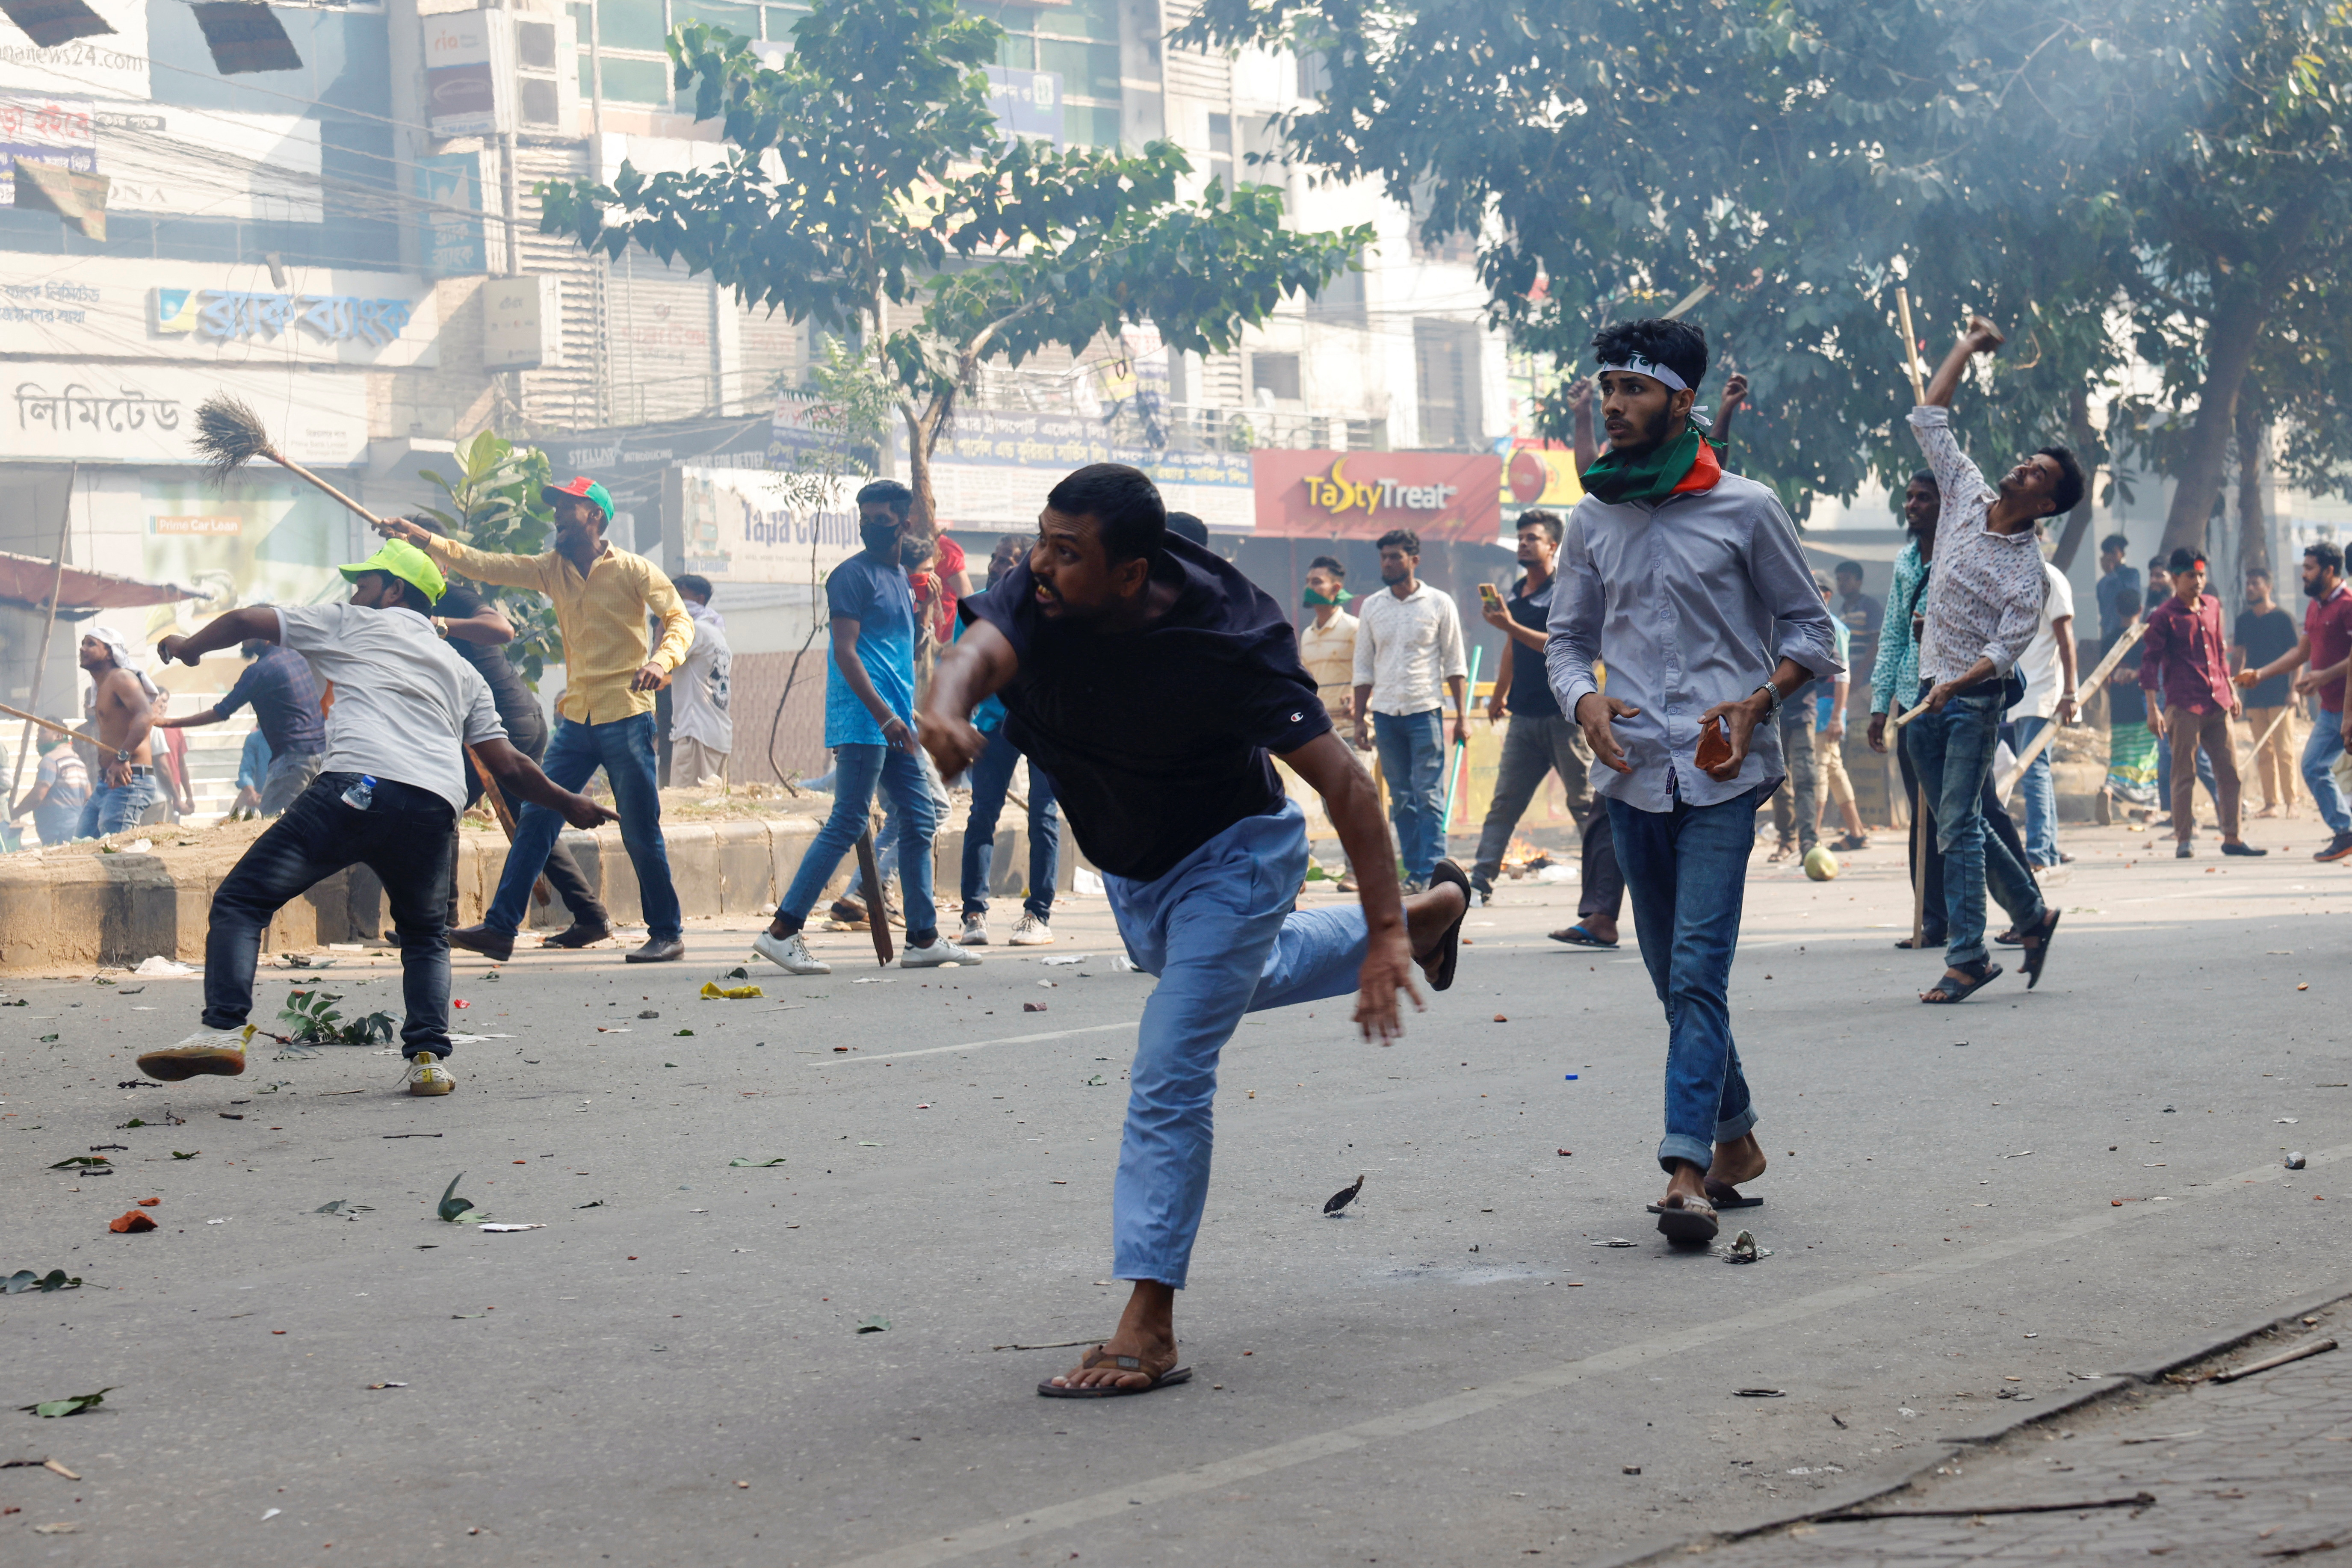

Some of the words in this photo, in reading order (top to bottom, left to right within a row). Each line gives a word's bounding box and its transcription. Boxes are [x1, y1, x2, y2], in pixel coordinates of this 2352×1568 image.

[303, 294, 411, 345] ব্যাংক
[11, 382, 181, 433] লিমিটেড
[160, 519, 189, 531] Prime
[191, 519, 210, 531] Car
[211, 519, 238, 532] Loan
[795, 506, 865, 550] Compl
